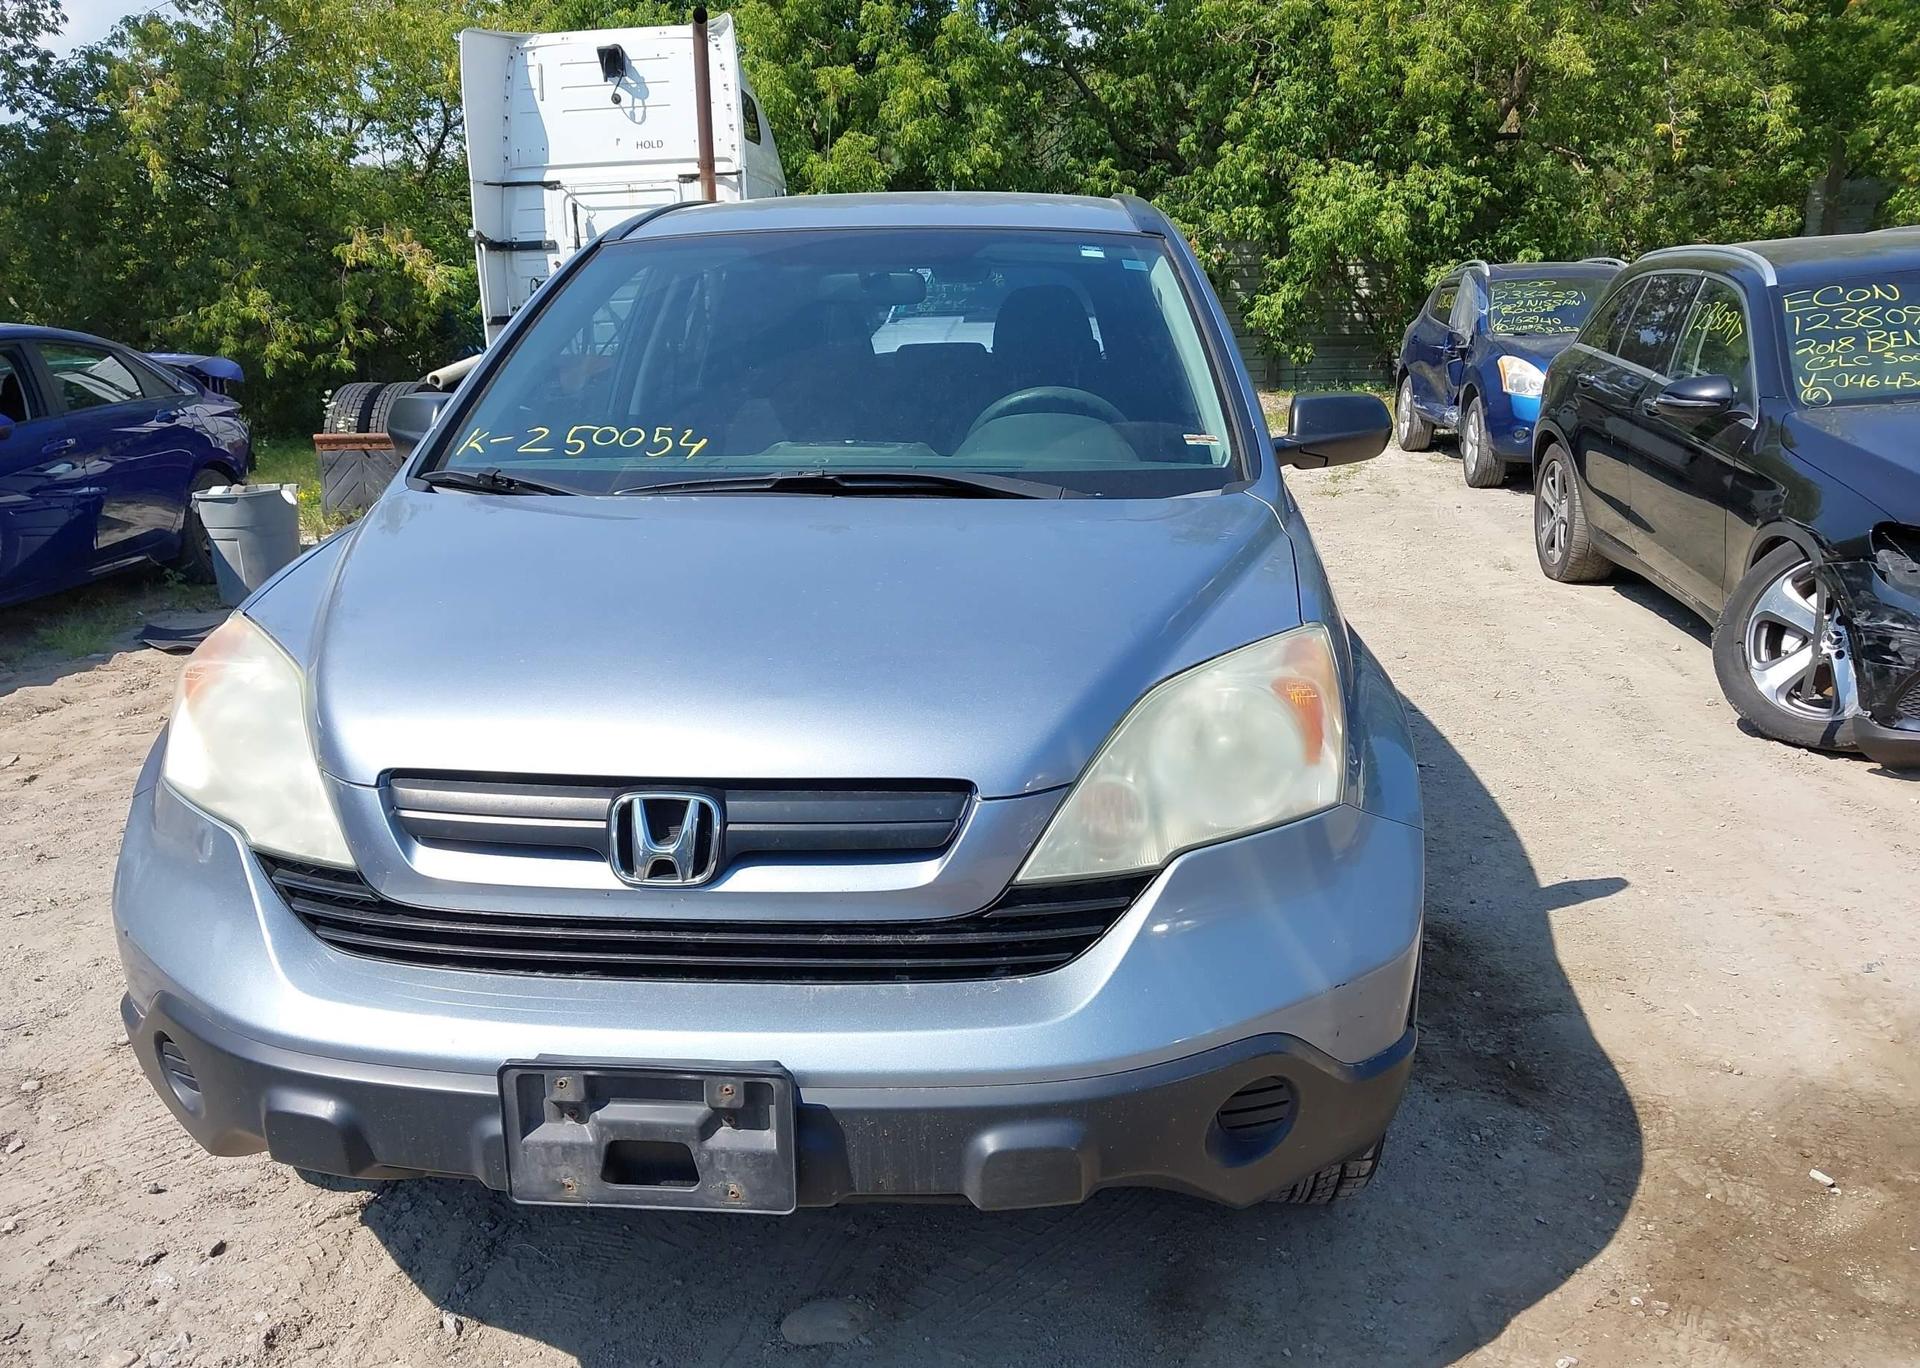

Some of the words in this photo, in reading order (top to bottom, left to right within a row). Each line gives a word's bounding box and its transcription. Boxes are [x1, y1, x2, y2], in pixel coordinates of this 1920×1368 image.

[636, 139, 664, 150] HOLD
[1527, 299, 1580, 308] NISSAN
[1782, 284, 1900, 313] ECON
[1795, 336, 1856, 355] 2018
[1799, 372, 1920, 389] V-04645
